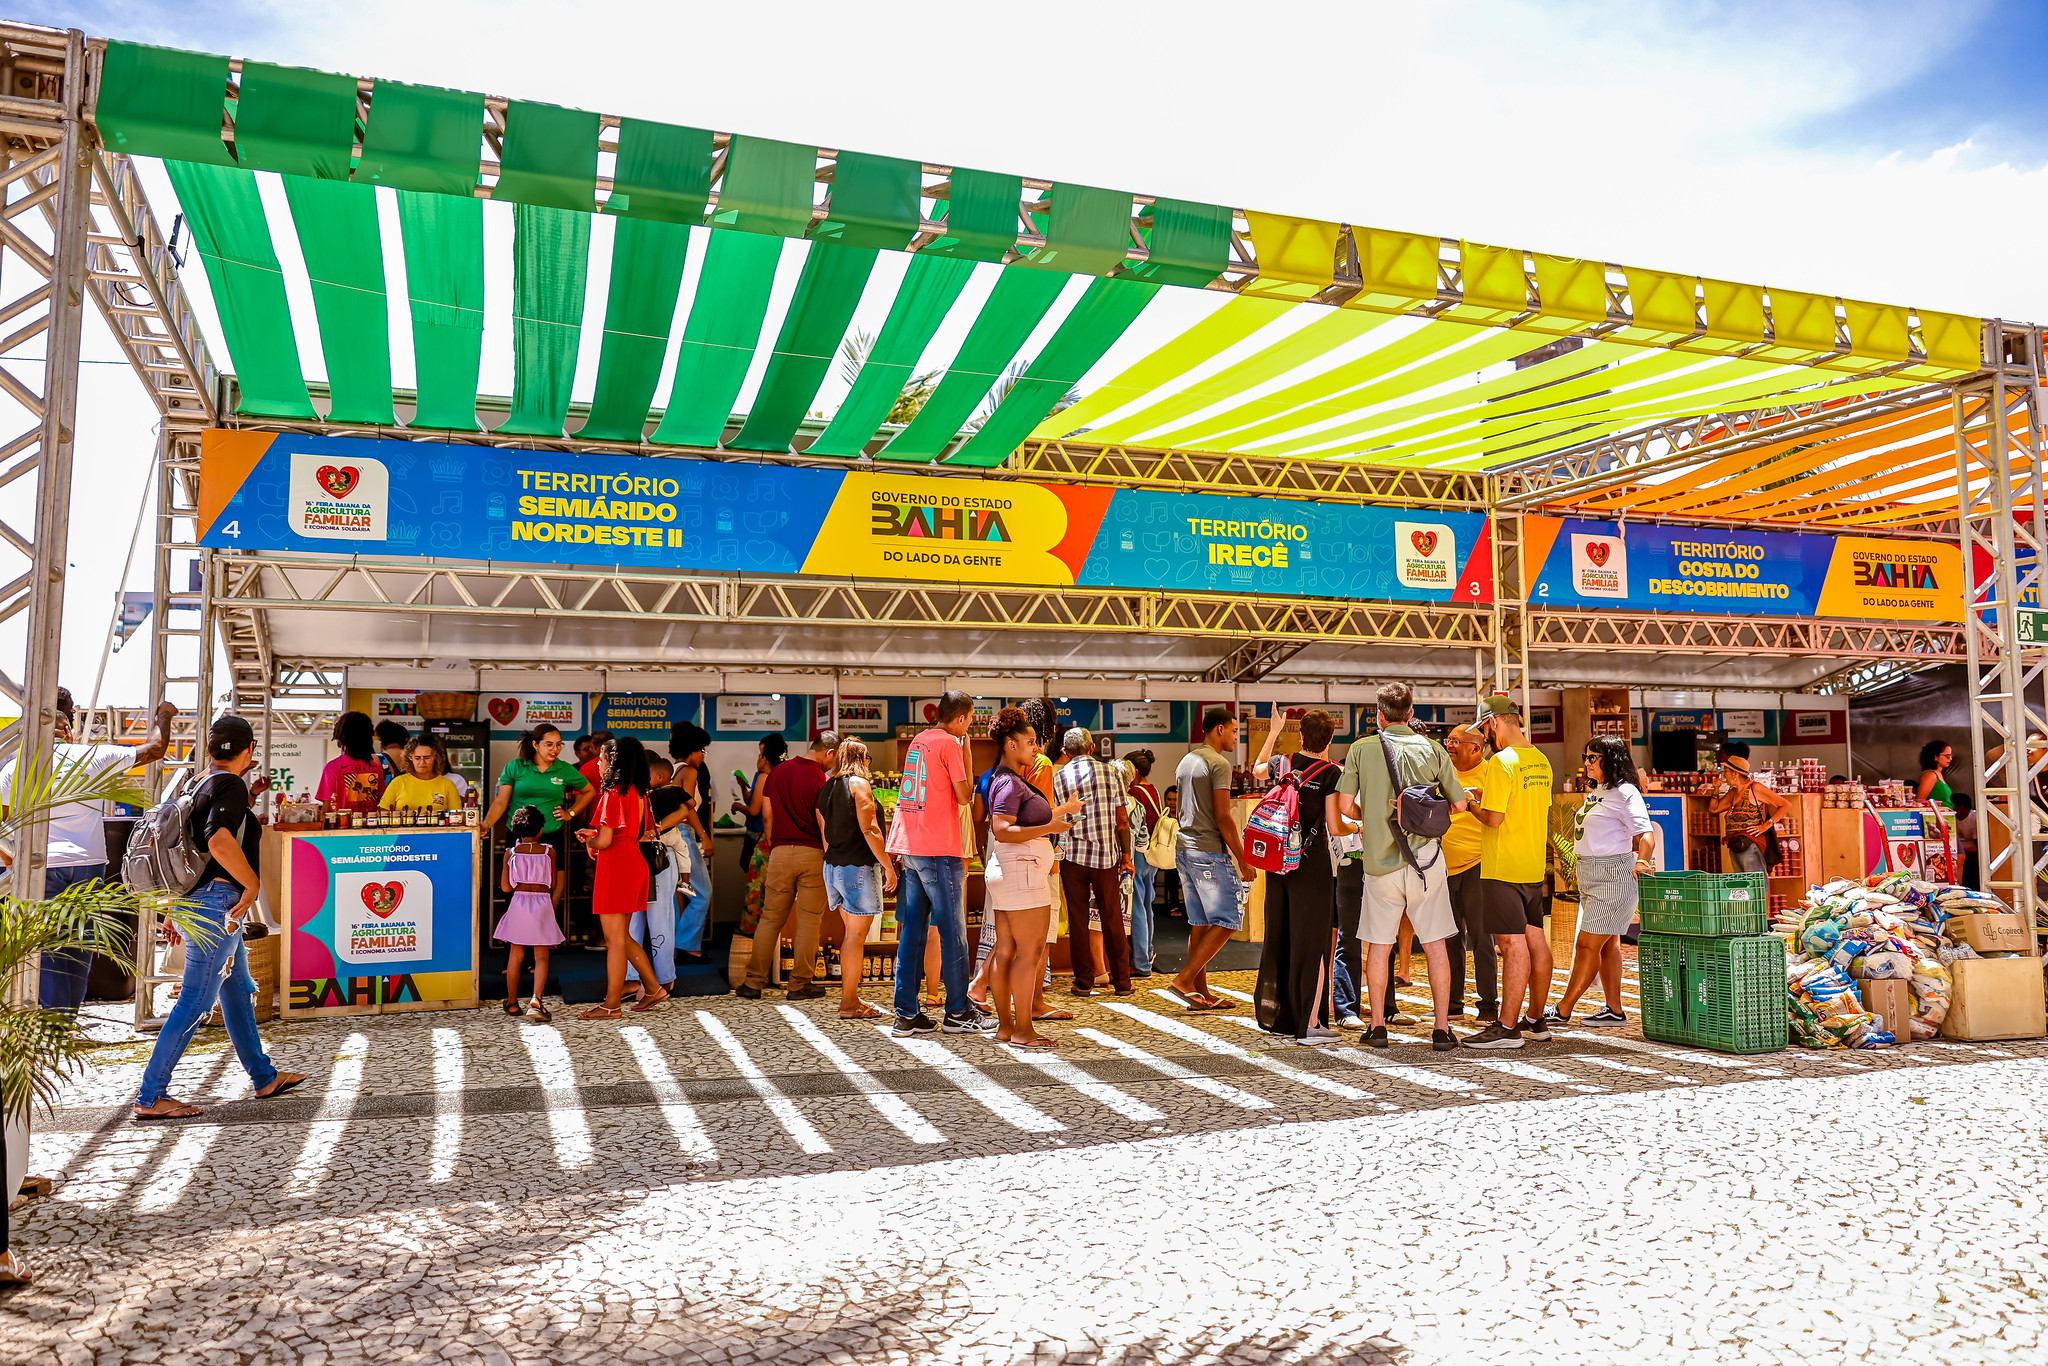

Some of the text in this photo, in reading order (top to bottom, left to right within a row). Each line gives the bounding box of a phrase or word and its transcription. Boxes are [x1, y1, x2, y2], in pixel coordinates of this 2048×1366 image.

[517, 470, 679, 497] TERRITÓRIO
[872, 491, 1012, 510] GOVERNO DO ESTADO
[305, 507, 370, 516] AGRICULTURA
[519, 495, 677, 522] SEMIÁRIDO
[304, 514, 371, 526] FAMILIAR
[872, 503, 1012, 542] BAHIA
[222, 520, 241, 538] 4
[512, 521, 682, 547] NORDESTE II
[1187, 518, 1308, 541] TERRITÓRIO
[1208, 541, 1289, 568] IRECÊ
[1671, 541, 1765, 560] TERRITÓRIO
[883, 551, 1002, 566] DO LADO DA GENTE
[1853, 552, 1937, 564] GOVERNO DO ESTADO
[1406, 569, 1447, 578] FAMILIAR
[1679, 560, 1759, 579] COSTA DO
[1854, 561, 1939, 589] BAHIA
[1469, 581, 1481, 596] 3
[1538, 583, 1549, 597] 2
[1582, 578, 1618, 588] FAMILIAR
[1649, 578, 1790, 599] DESCOBRIMENTO
[1877, 598, 1897, 607] LADO
[1911, 600, 1934, 608] GENTE
[607, 696, 668, 706] TERRITÓRIO
[379, 703, 420, 716] BAH
[526, 711, 572, 719] FAMILIAR
[607, 707, 666, 718] SEMIÁRIDO
[838, 708, 882, 719] BAHIA
[607, 720, 671, 729] NORDESTE II
[271, 742, 298, 750] pedido
[359, 845, 411, 854] TERRITÓRIO
[331, 855, 382, 865] SEMIÁRIDO
[383, 854, 431, 862] NORDESTE
[351, 927, 416, 937] AGRICULTURA
[351, 935, 417, 950] FAMILIAR
[290, 973, 423, 1009] BAHIA
